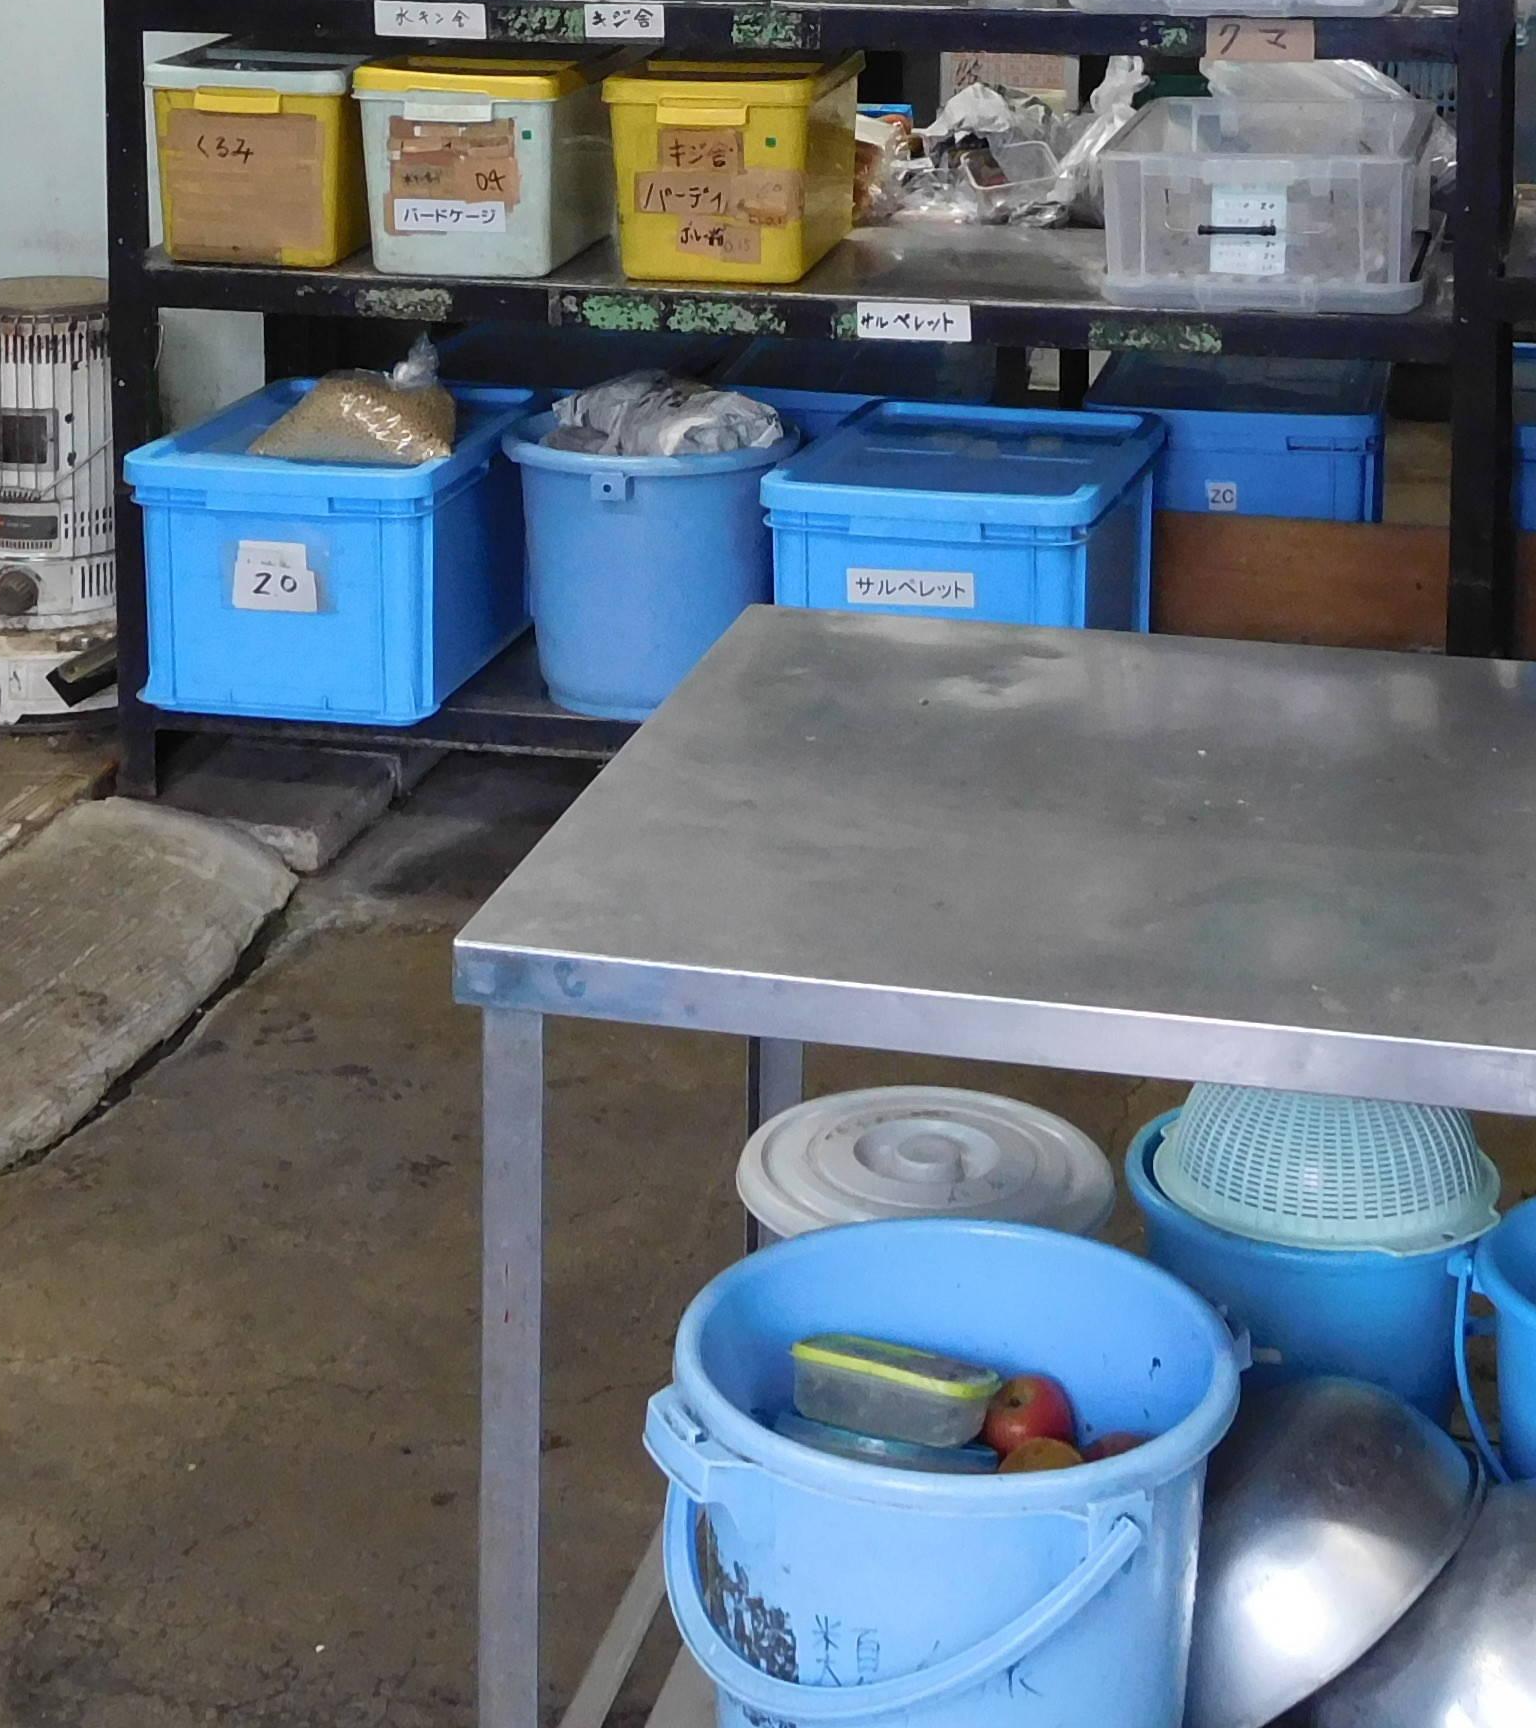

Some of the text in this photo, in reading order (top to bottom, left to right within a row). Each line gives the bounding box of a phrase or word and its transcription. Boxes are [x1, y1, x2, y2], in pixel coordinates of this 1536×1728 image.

[1219, 23, 1287, 55] クマ
[196, 135, 254, 164] くるみ
[404, 208, 496, 224] バードケージ
[855, 577, 966, 600] サルペレット
